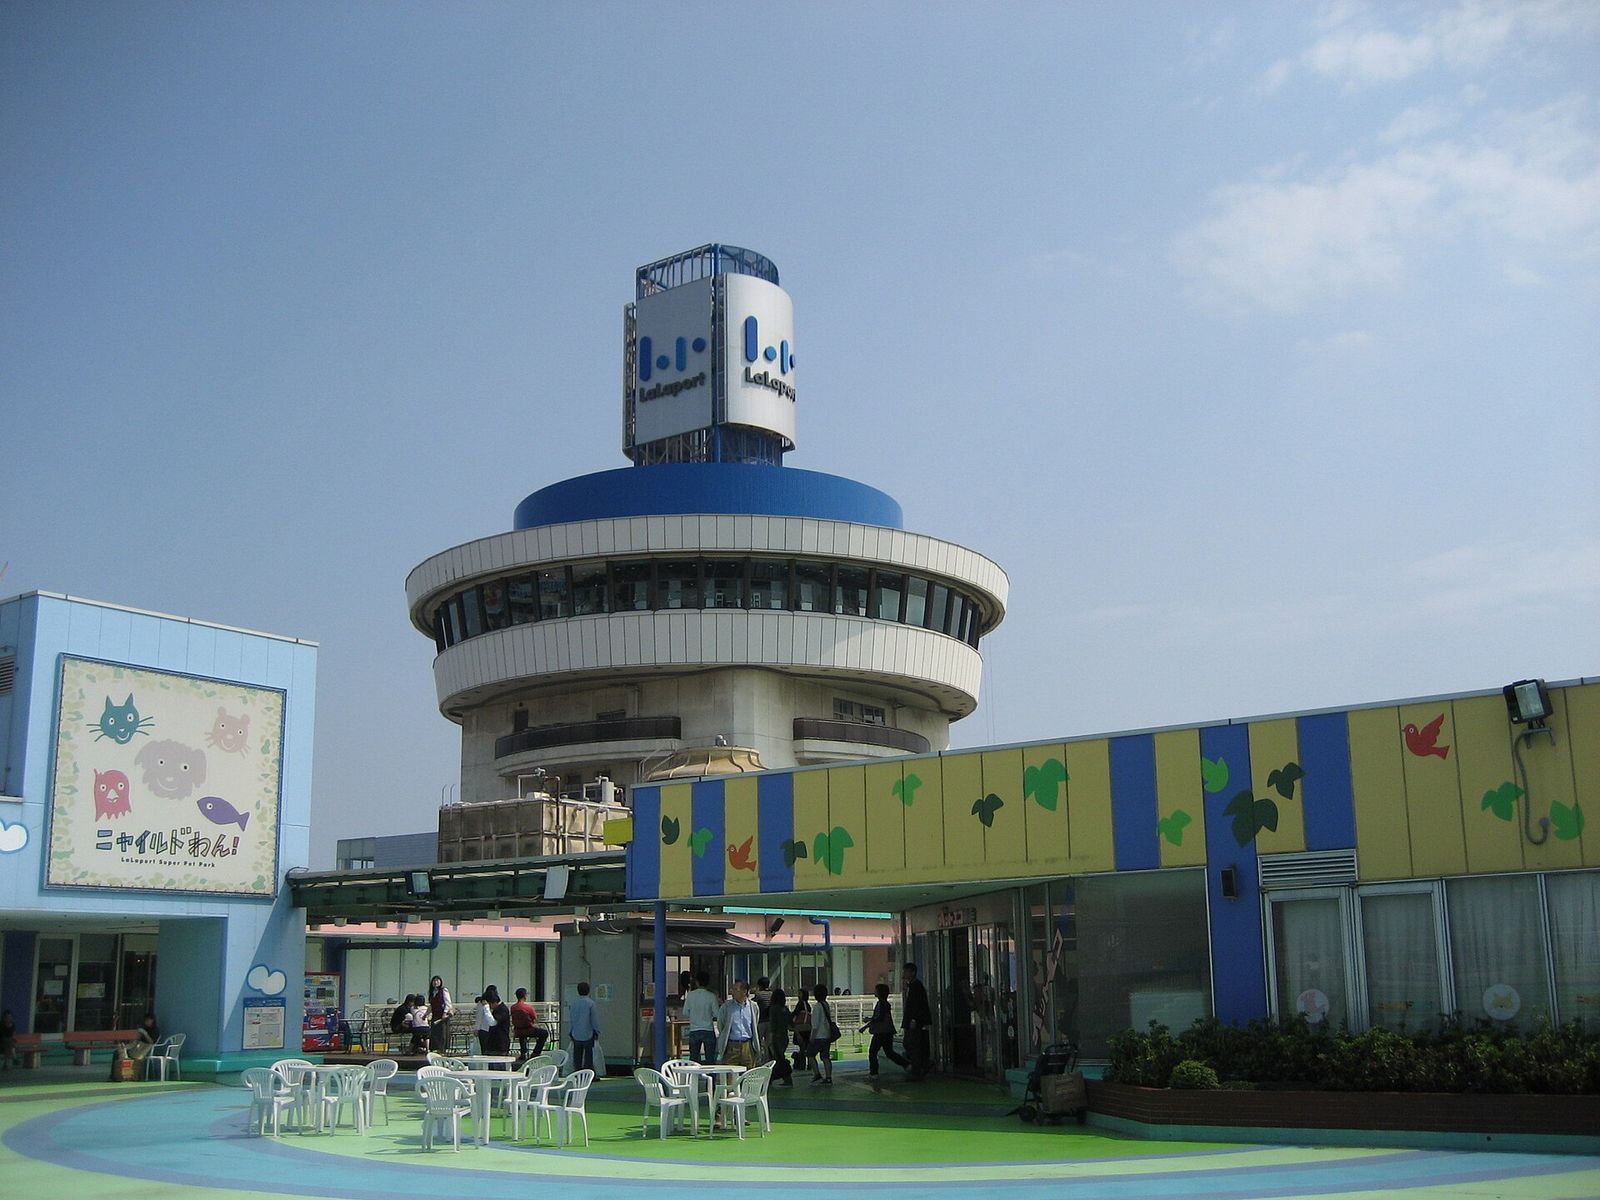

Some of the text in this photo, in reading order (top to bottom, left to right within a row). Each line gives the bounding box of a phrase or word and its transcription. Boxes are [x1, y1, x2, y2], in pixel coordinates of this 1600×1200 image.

[639, 372, 706, 402] LaLaport
[745, 366, 796, 402] LaLapor
[159, 859, 180, 867] Super
